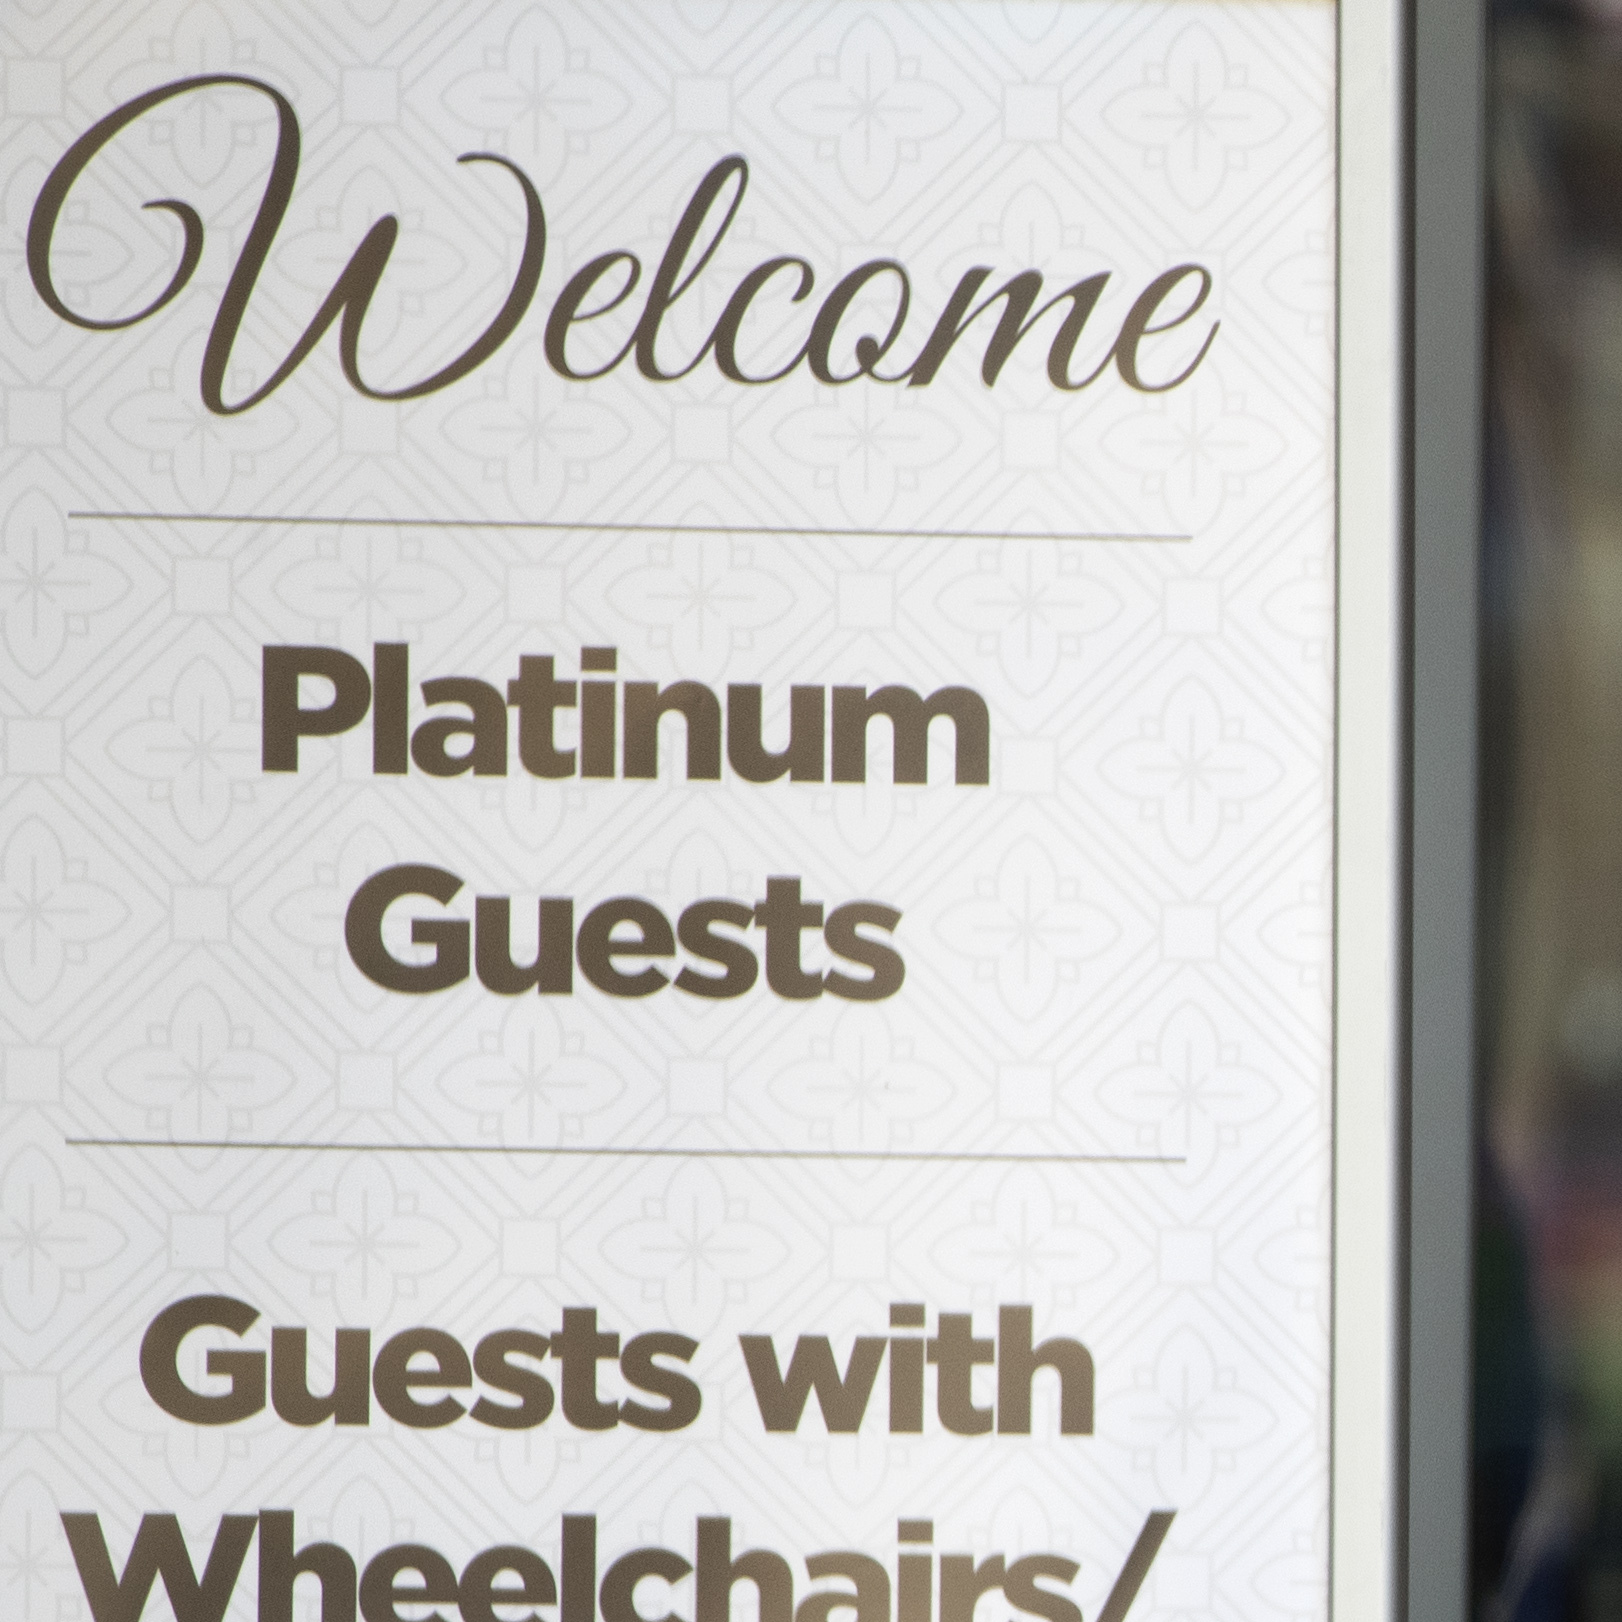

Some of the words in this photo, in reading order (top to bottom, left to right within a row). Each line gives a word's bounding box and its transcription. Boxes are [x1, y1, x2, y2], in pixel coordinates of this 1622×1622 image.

[26, 72, 1220, 417] Welcome
[262, 641, 990, 785] Platinum
[345, 863, 906, 1002] Guests
[139, 1293, 702, 1433] Guests
[739, 1303, 1095, 1436] with
